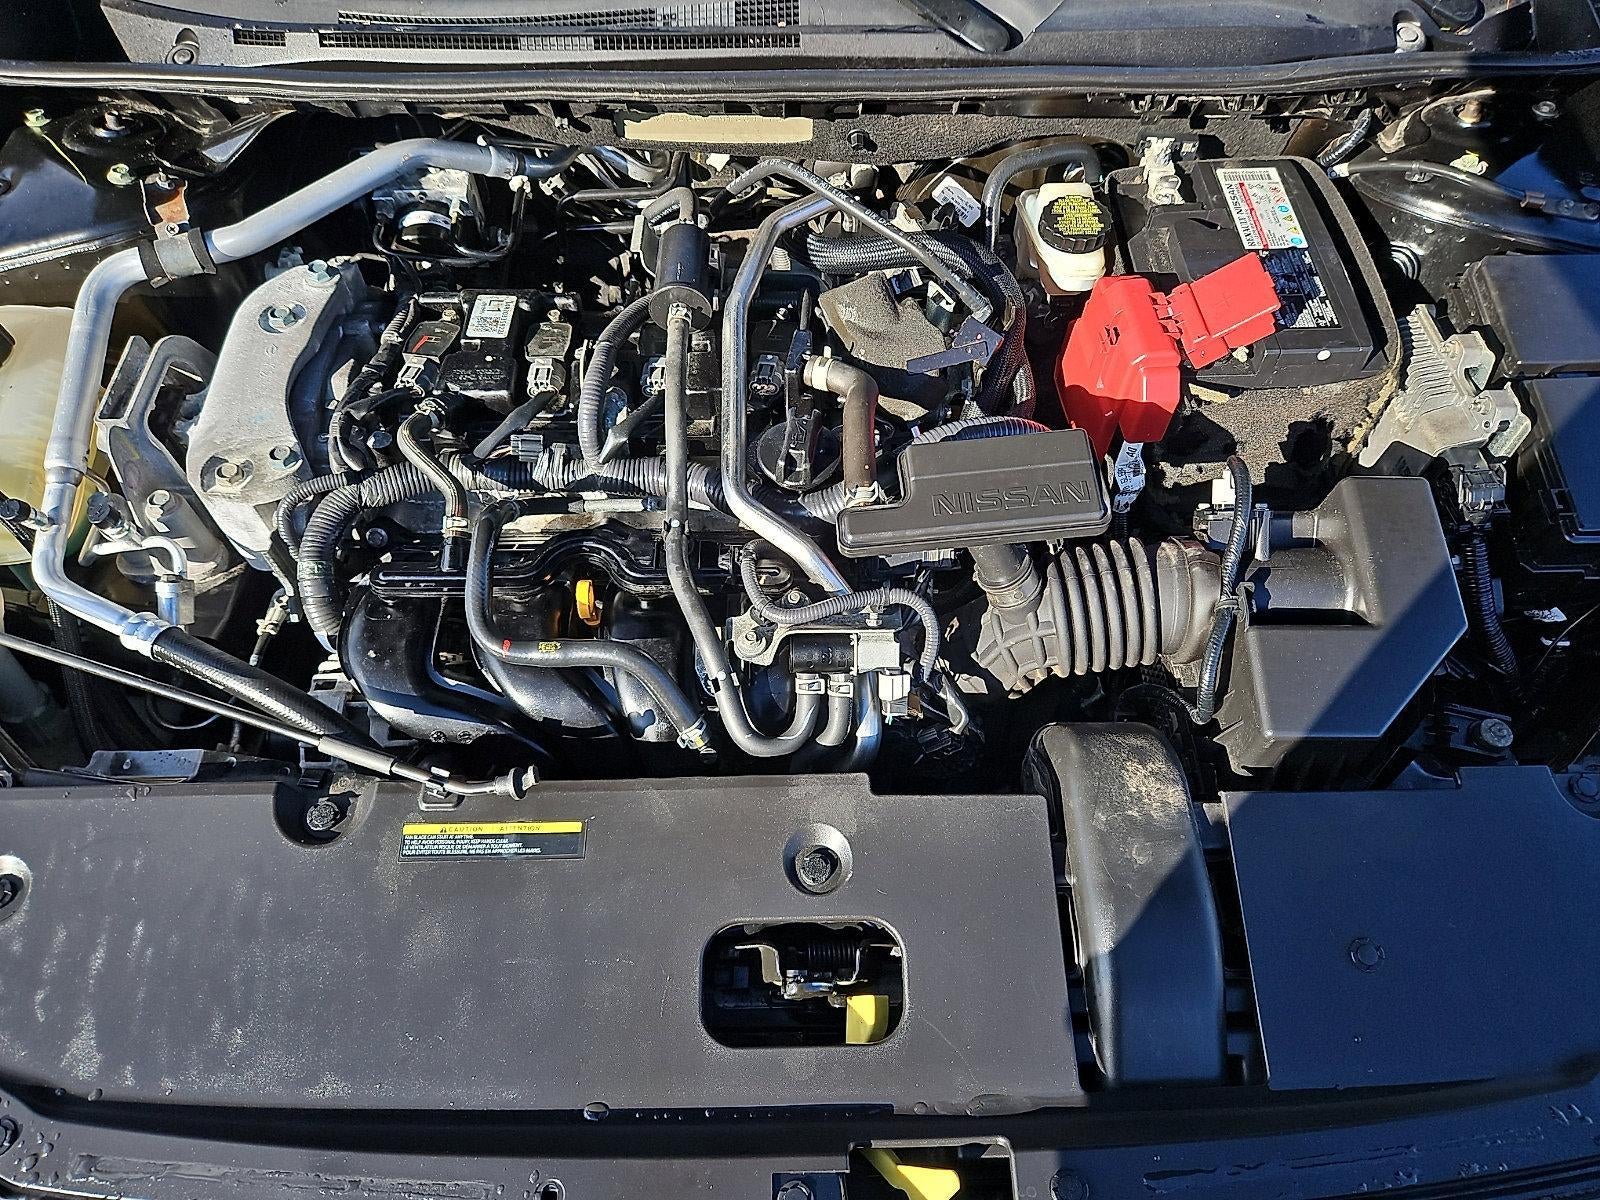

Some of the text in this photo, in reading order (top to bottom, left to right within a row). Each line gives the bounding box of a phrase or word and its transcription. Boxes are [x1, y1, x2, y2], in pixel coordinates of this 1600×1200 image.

[832, 189, 849, 201] KINK
[1225, 183, 1244, 215] NISSAN
[931, 481, 1091, 517] NISSAN
